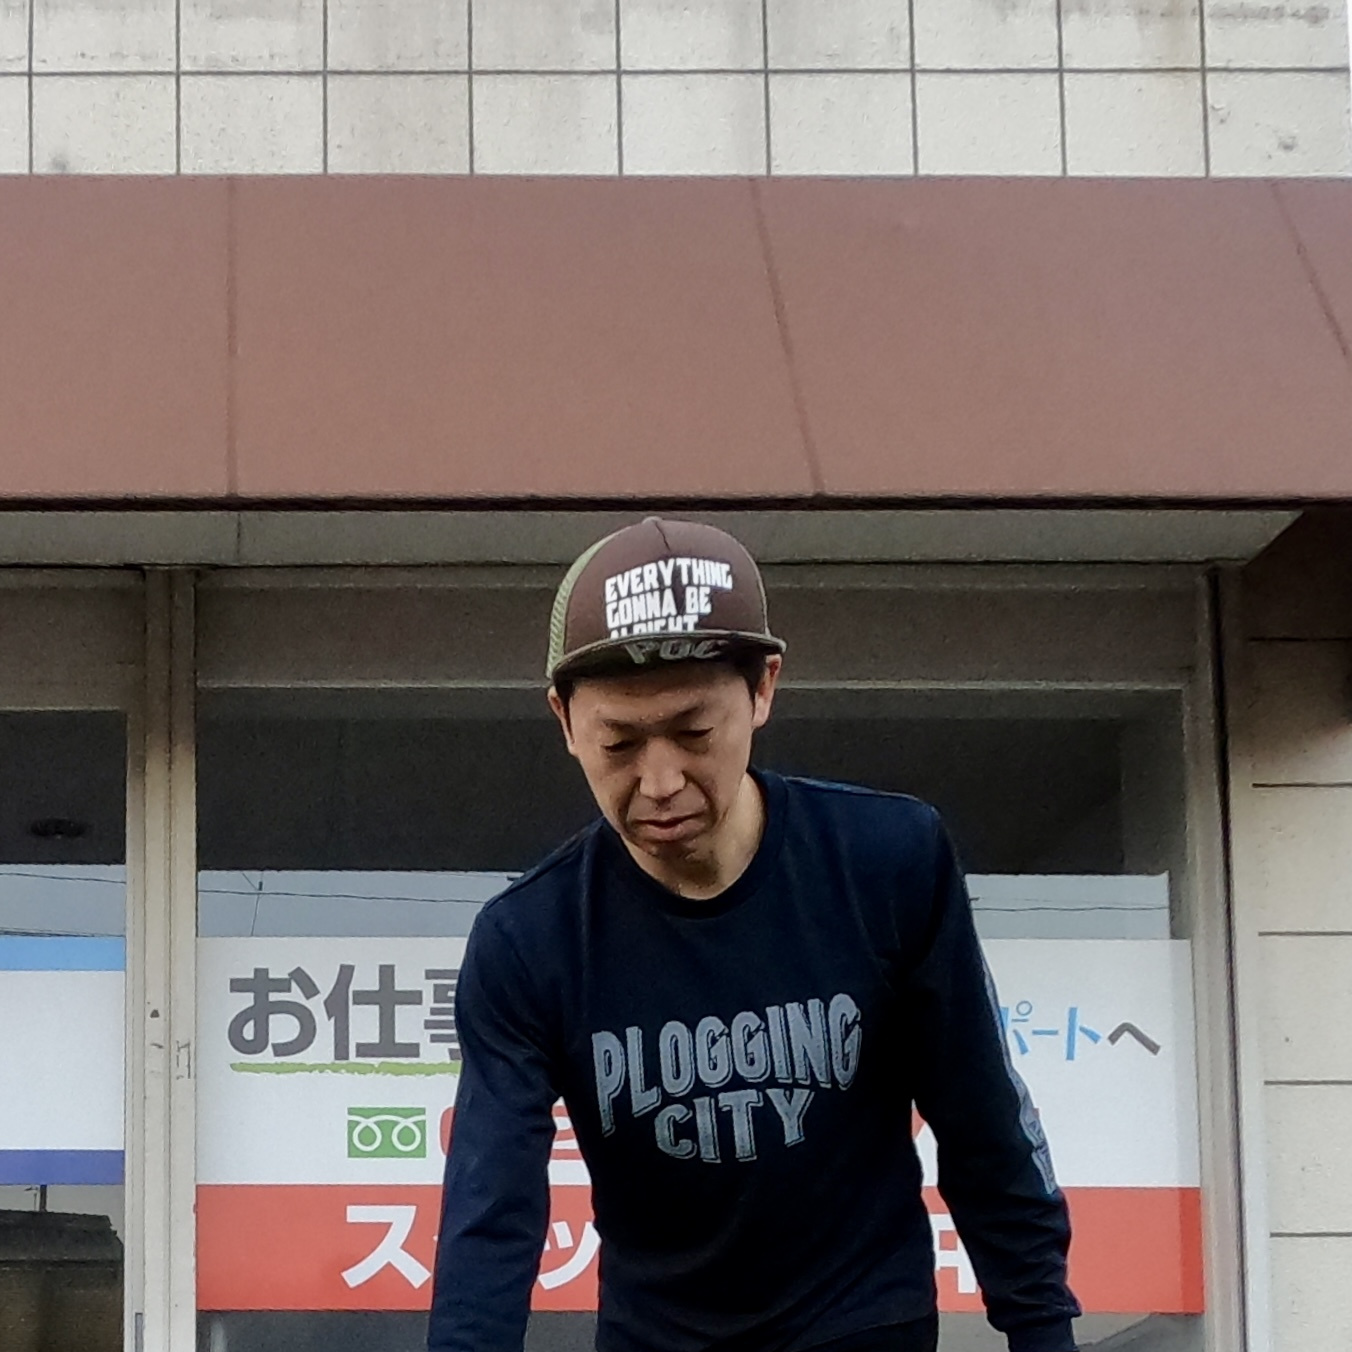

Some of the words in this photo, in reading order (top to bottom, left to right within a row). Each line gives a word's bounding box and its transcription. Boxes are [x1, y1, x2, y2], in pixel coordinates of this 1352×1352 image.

[605, 557, 733, 604] EVERYTHING
[606, 588, 677, 629] GONNA
[685, 586, 712, 615] BE
[591, 992, 862, 1137] PLOGGING
[654, 1088, 815, 1163] CITY
